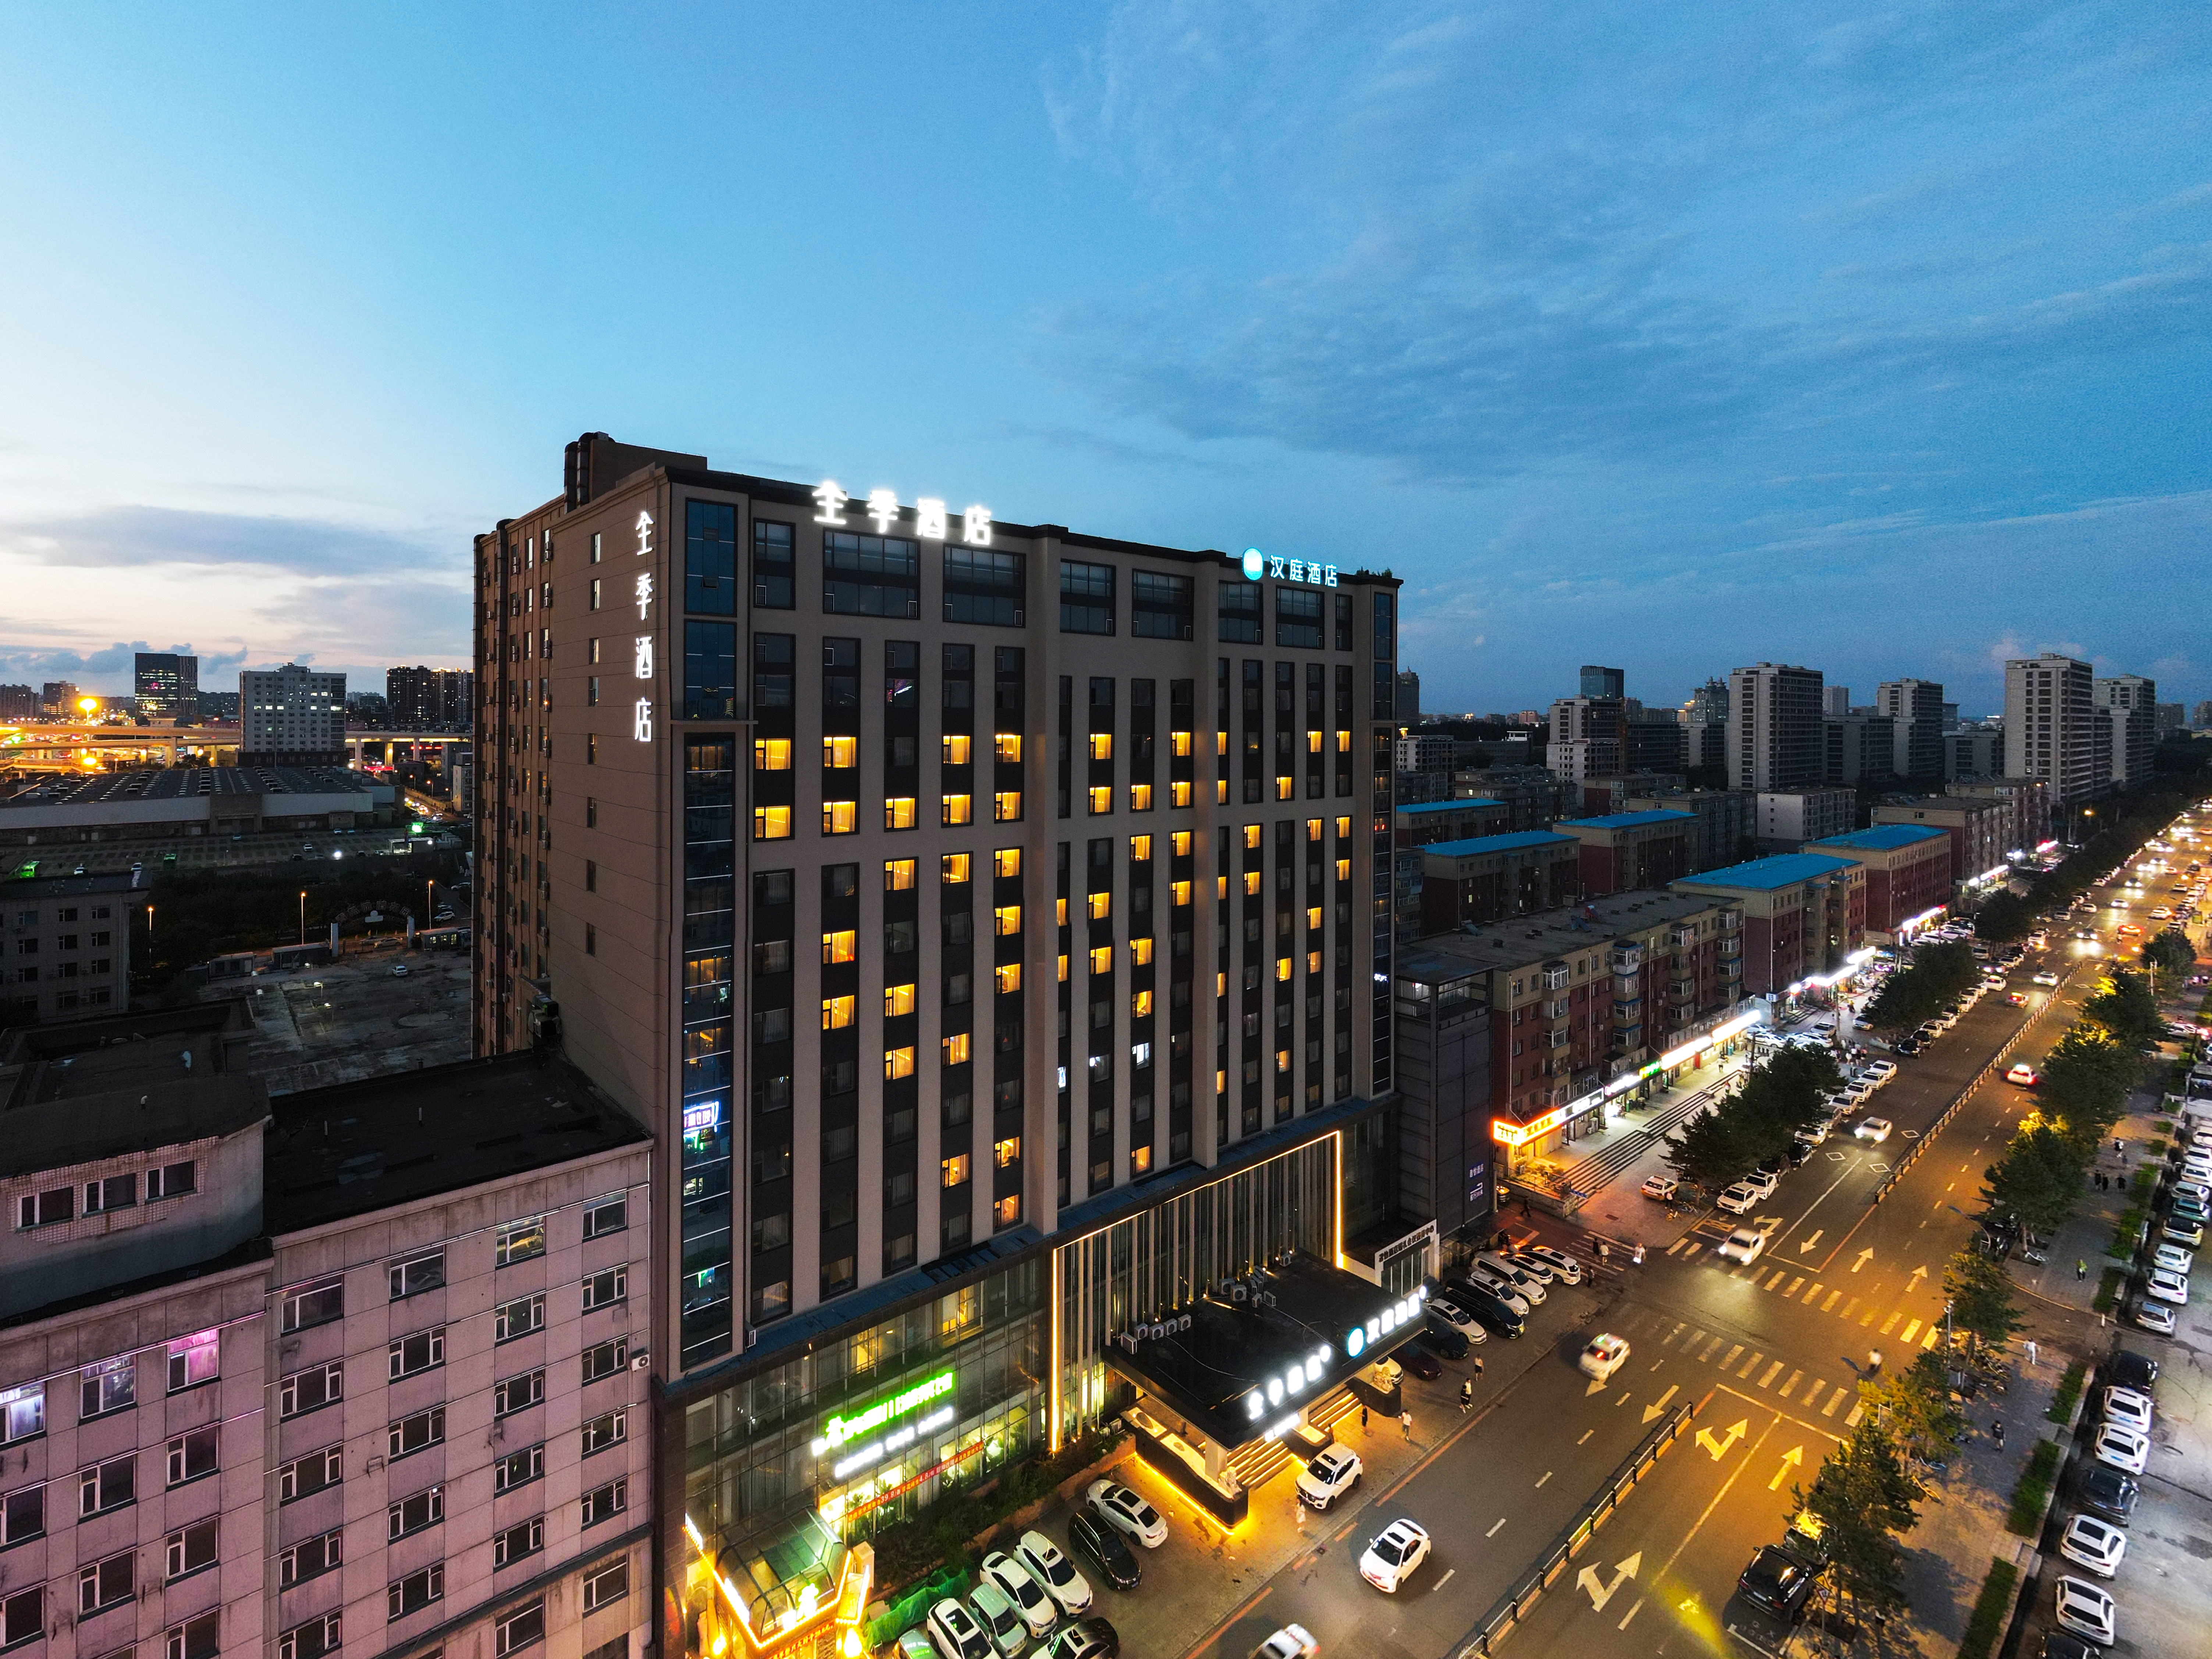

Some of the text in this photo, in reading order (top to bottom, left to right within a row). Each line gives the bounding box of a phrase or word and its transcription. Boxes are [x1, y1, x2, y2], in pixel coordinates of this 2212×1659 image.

[812, 481, 991, 545] 全季酒店
[1270, 554, 1338, 588] 汉庭酒店
[635, 511, 654, 742] 全季酒店
